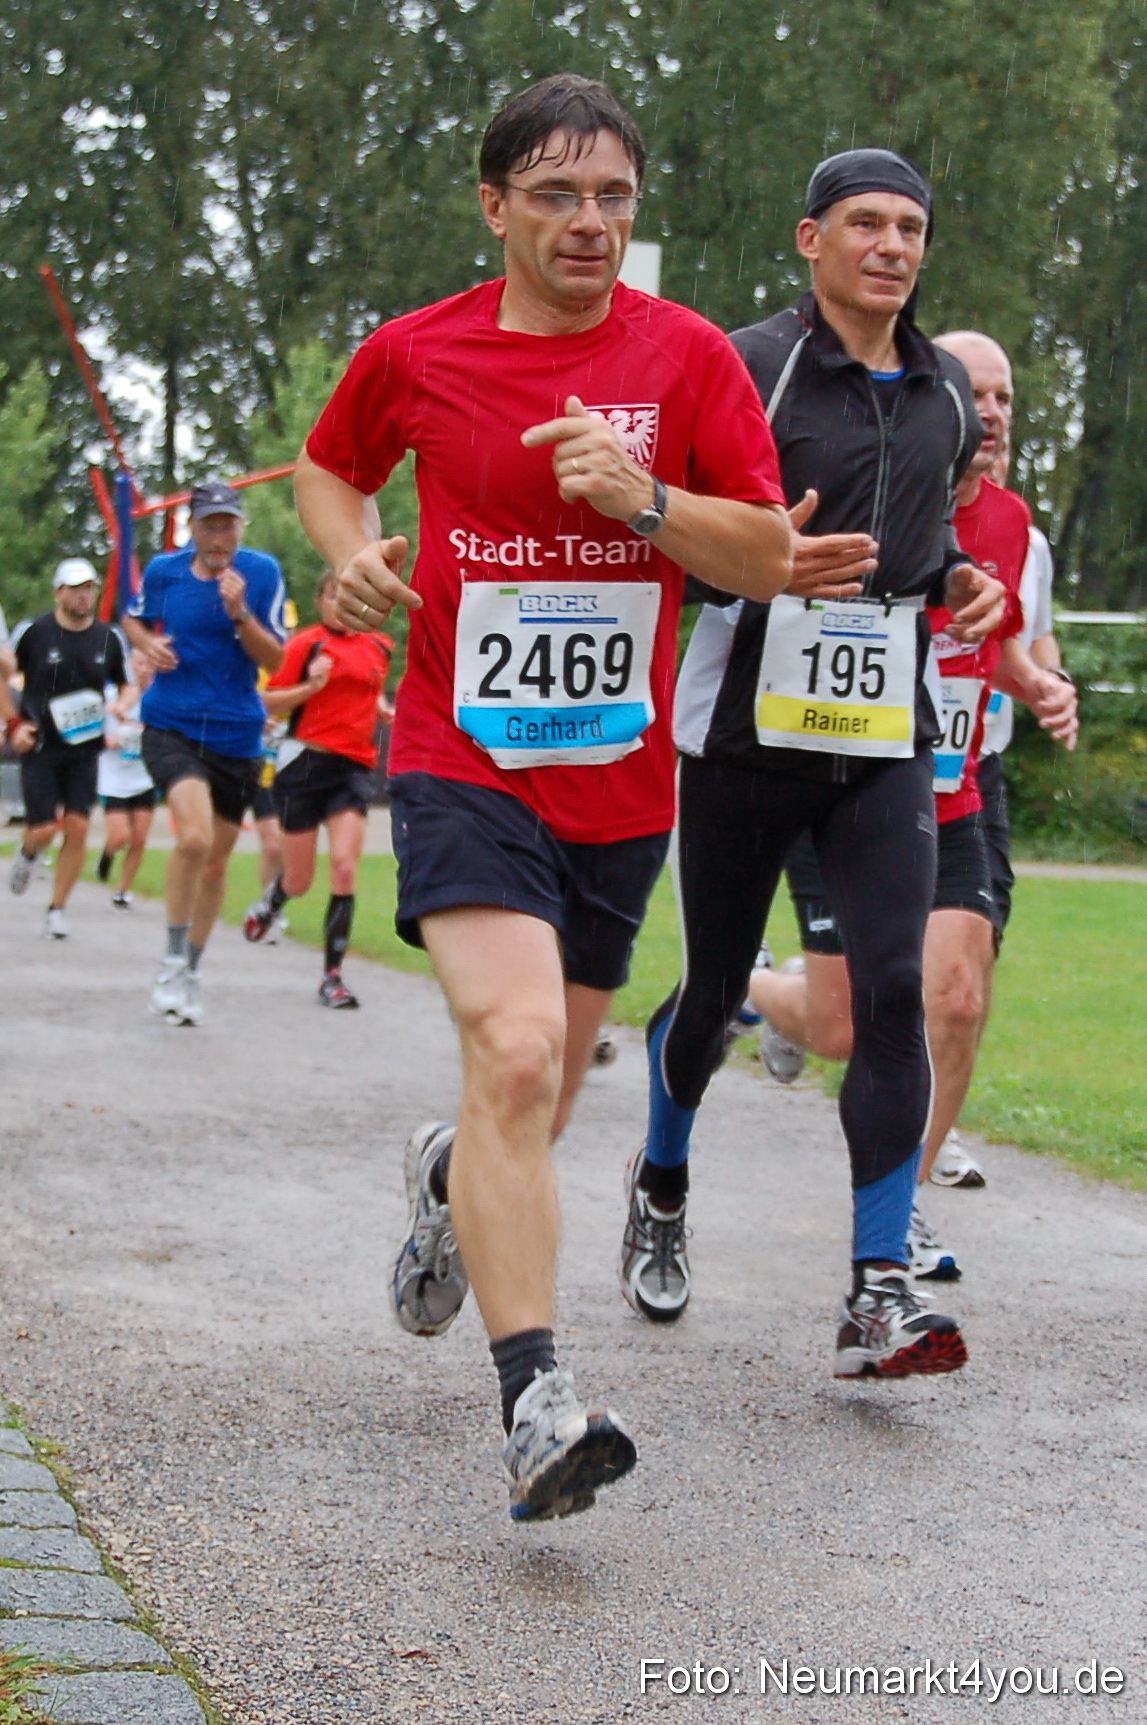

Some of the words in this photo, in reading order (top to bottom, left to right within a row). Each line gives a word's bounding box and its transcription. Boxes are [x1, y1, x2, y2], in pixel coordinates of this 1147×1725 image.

[519, 595, 598, 612] BOCK
[822, 612, 875, 630] BOCK
[478, 632, 633, 700] 2469
[801, 642, 887, 700] 195
[506, 714, 604, 742] Gerhard
[802, 708, 870, 734] Rainer
